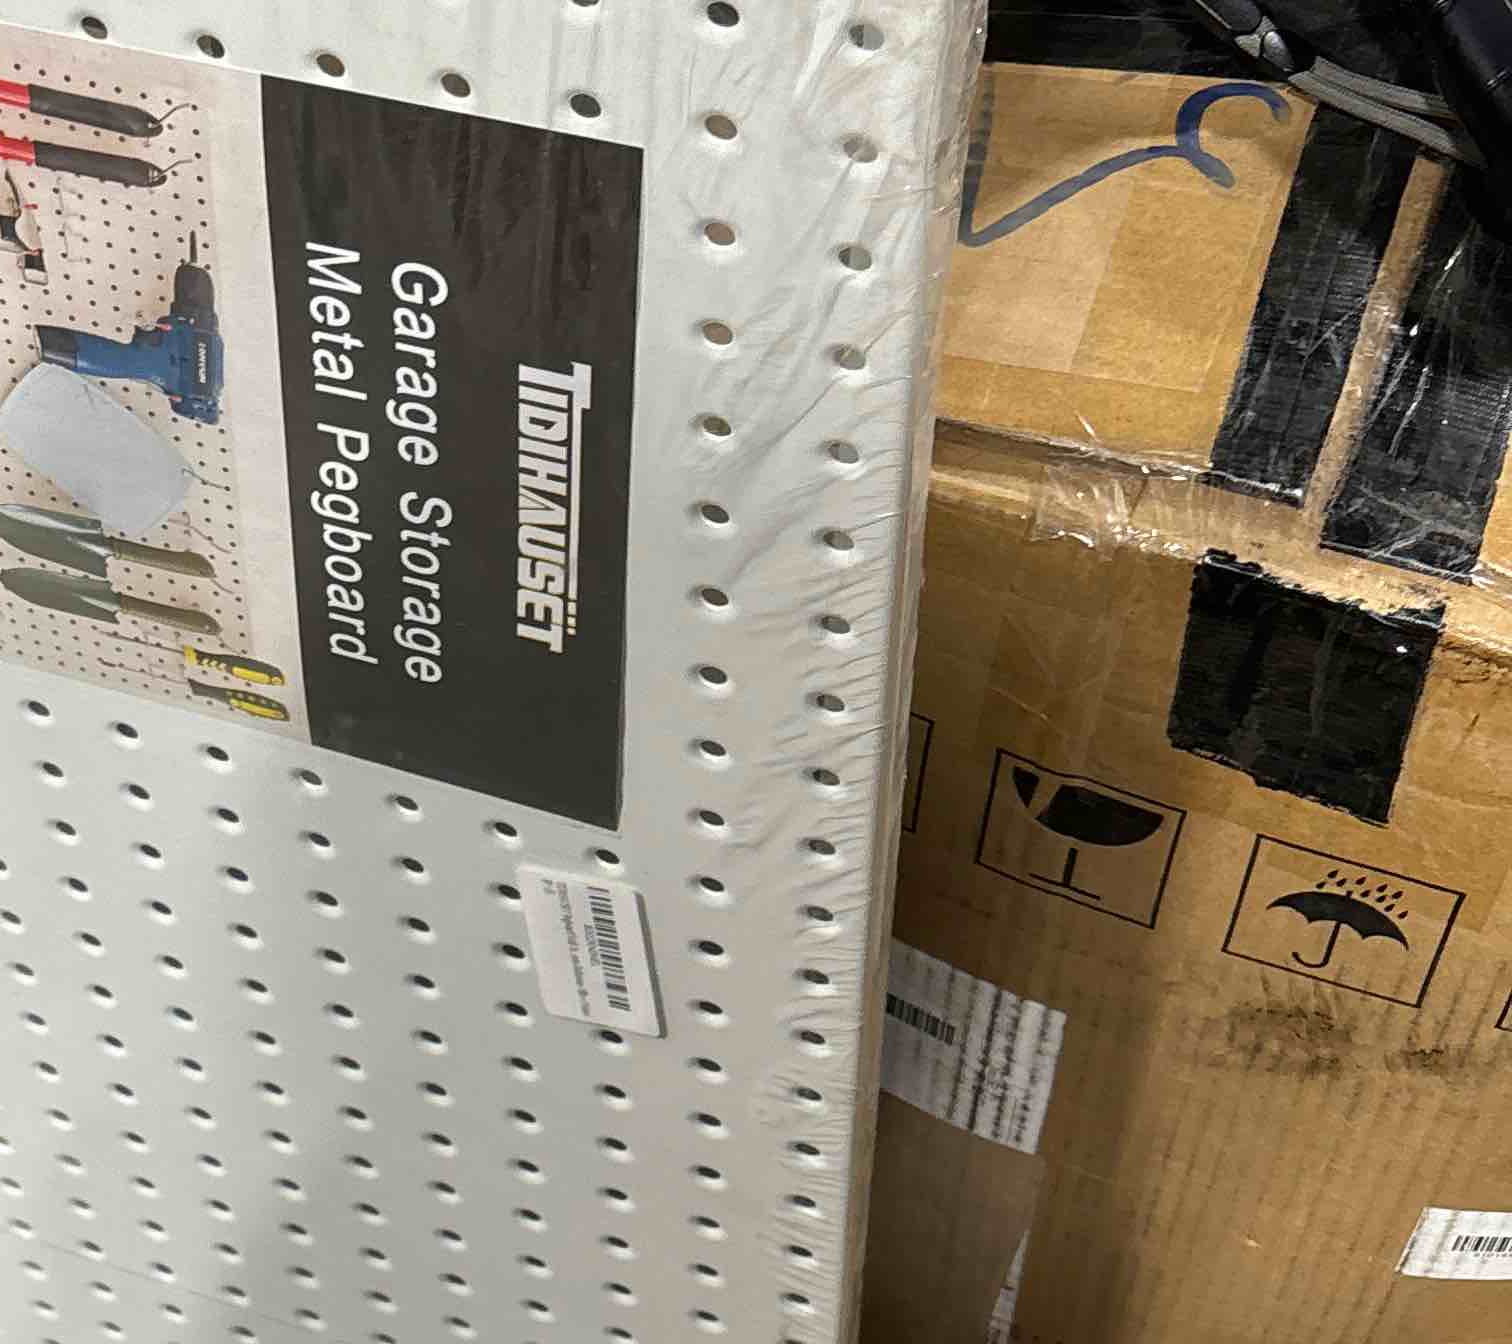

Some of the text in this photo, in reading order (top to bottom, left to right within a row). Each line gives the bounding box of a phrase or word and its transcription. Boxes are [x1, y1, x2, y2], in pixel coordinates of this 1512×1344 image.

[304, 240, 380, 666] Metal Pegboard
[384, 261, 453, 685] Garage Storage
